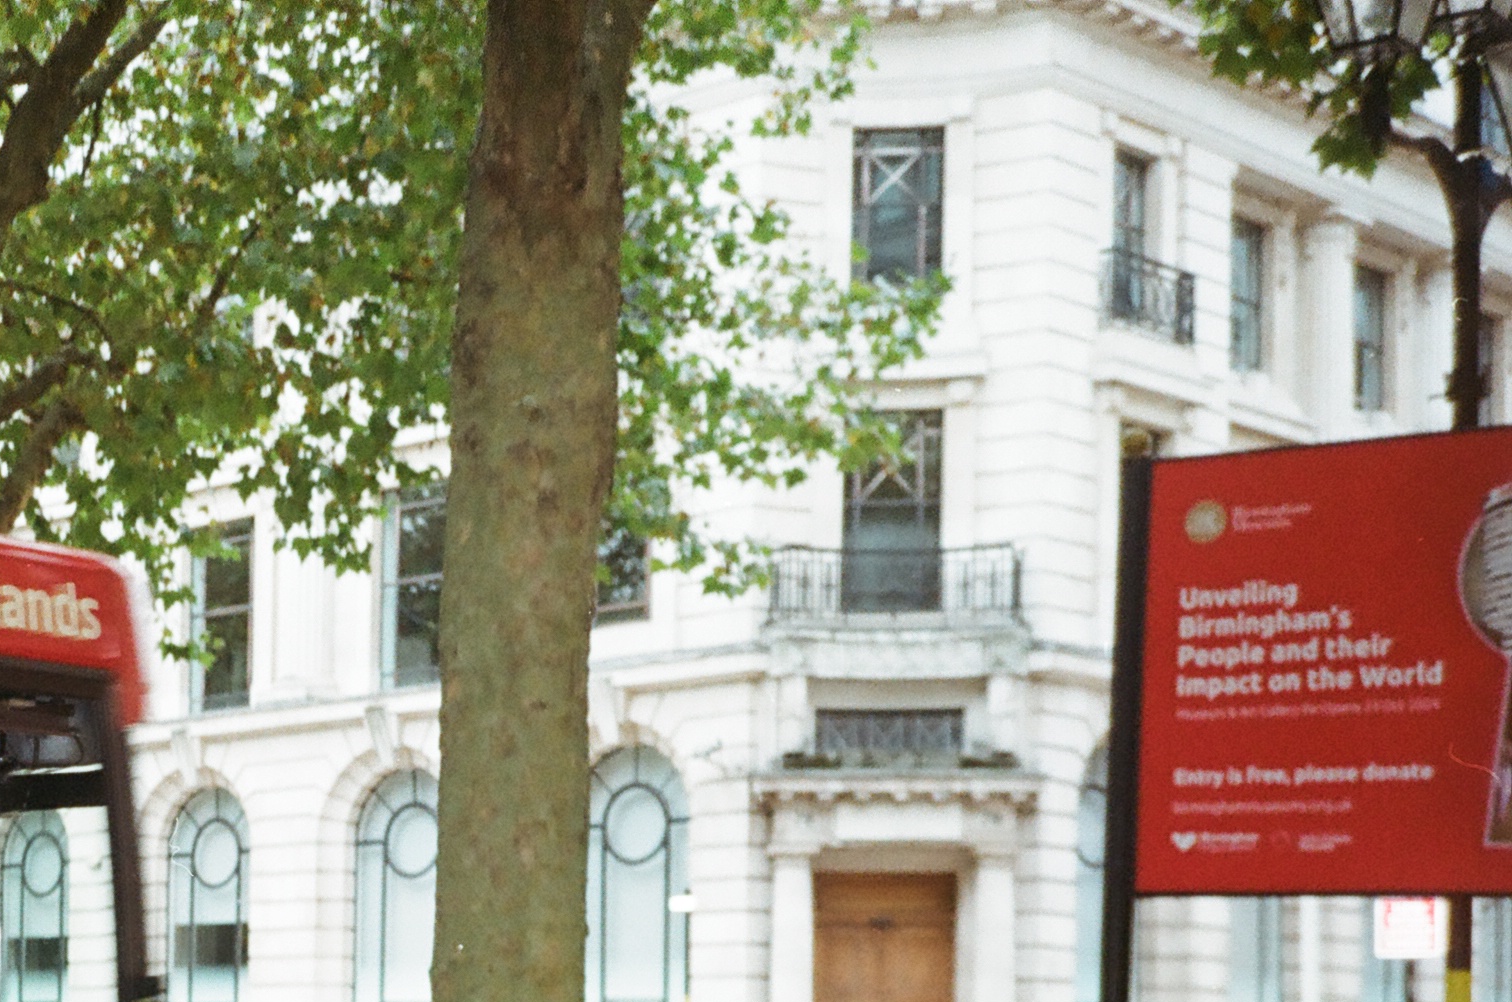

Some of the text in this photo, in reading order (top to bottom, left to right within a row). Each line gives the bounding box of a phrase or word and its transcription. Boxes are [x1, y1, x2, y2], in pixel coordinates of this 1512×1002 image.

[1179, 580, 1298, 609] Unveiling
[1179, 605, 1352, 638] Birmingham's
[1178, 633, 1392, 668] People and their
[1176, 660, 1443, 699] Impact on the World
[1173, 768, 1224, 788] Entry
[1294, 764, 1359, 786] please
[1363, 763, 1435, 782] donate
